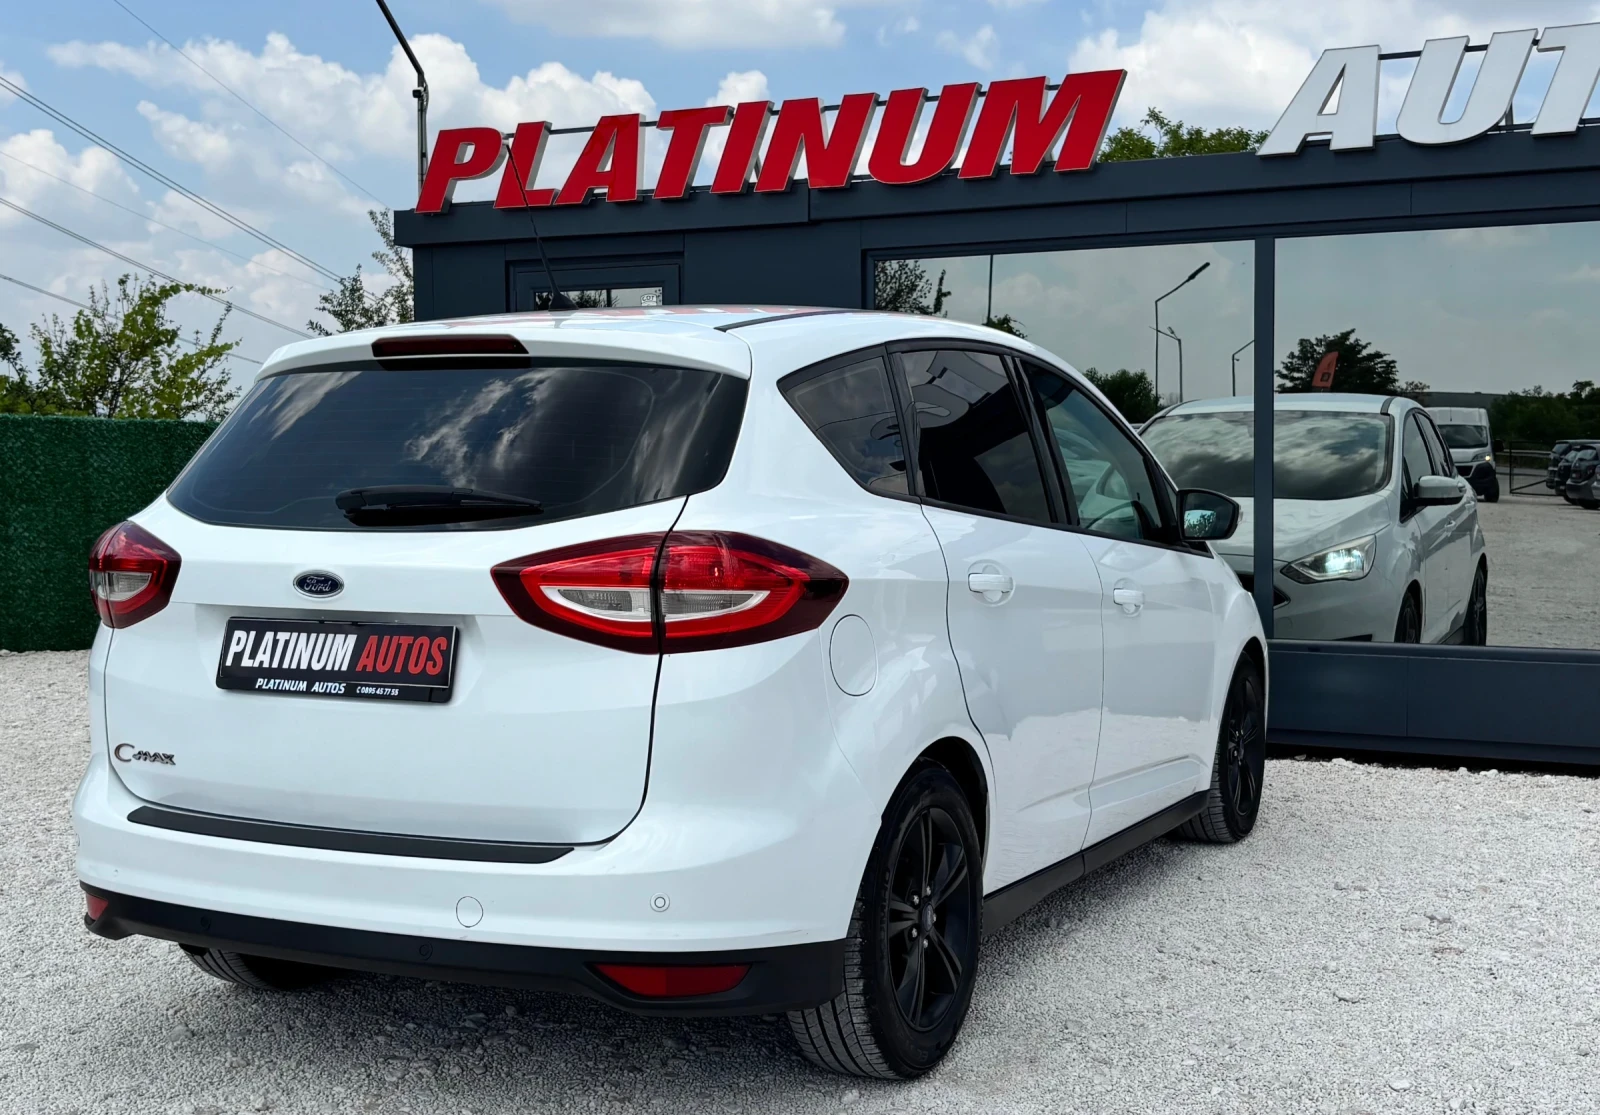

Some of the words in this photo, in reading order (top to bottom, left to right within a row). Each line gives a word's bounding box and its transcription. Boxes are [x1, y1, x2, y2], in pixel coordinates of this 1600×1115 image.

[414, 69, 1128, 214] PLATINUM
[304, 576, 332, 591] Ford
[225, 630, 358, 671] PLATINUM
[356, 635, 447, 675] AUTOS
[255, 678, 307, 692] PLATINUM
[311, 682, 346, 694] AUTOS
